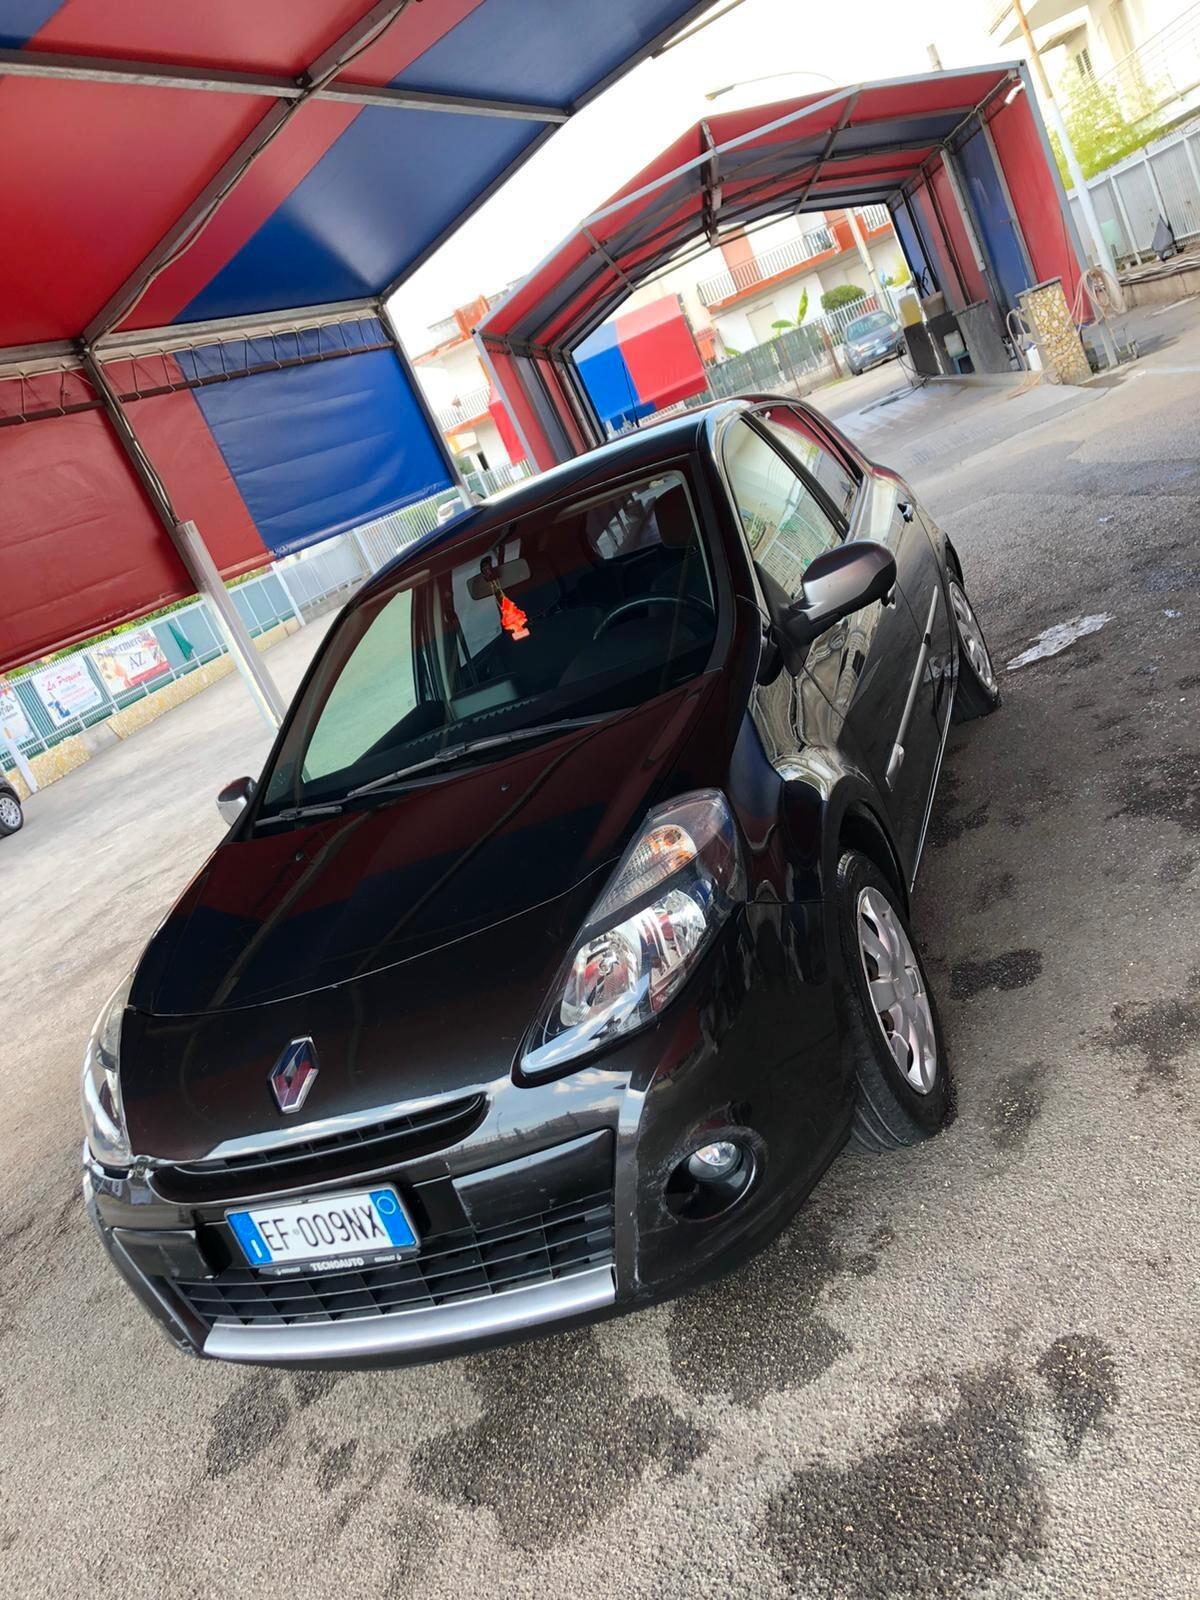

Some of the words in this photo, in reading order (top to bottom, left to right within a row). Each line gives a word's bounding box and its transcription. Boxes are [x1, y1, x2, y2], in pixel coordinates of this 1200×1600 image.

[129, 651, 146, 670] AZ
[258, 1218, 290, 1252] EF
[296, 1204, 386, 1247] 009NX
